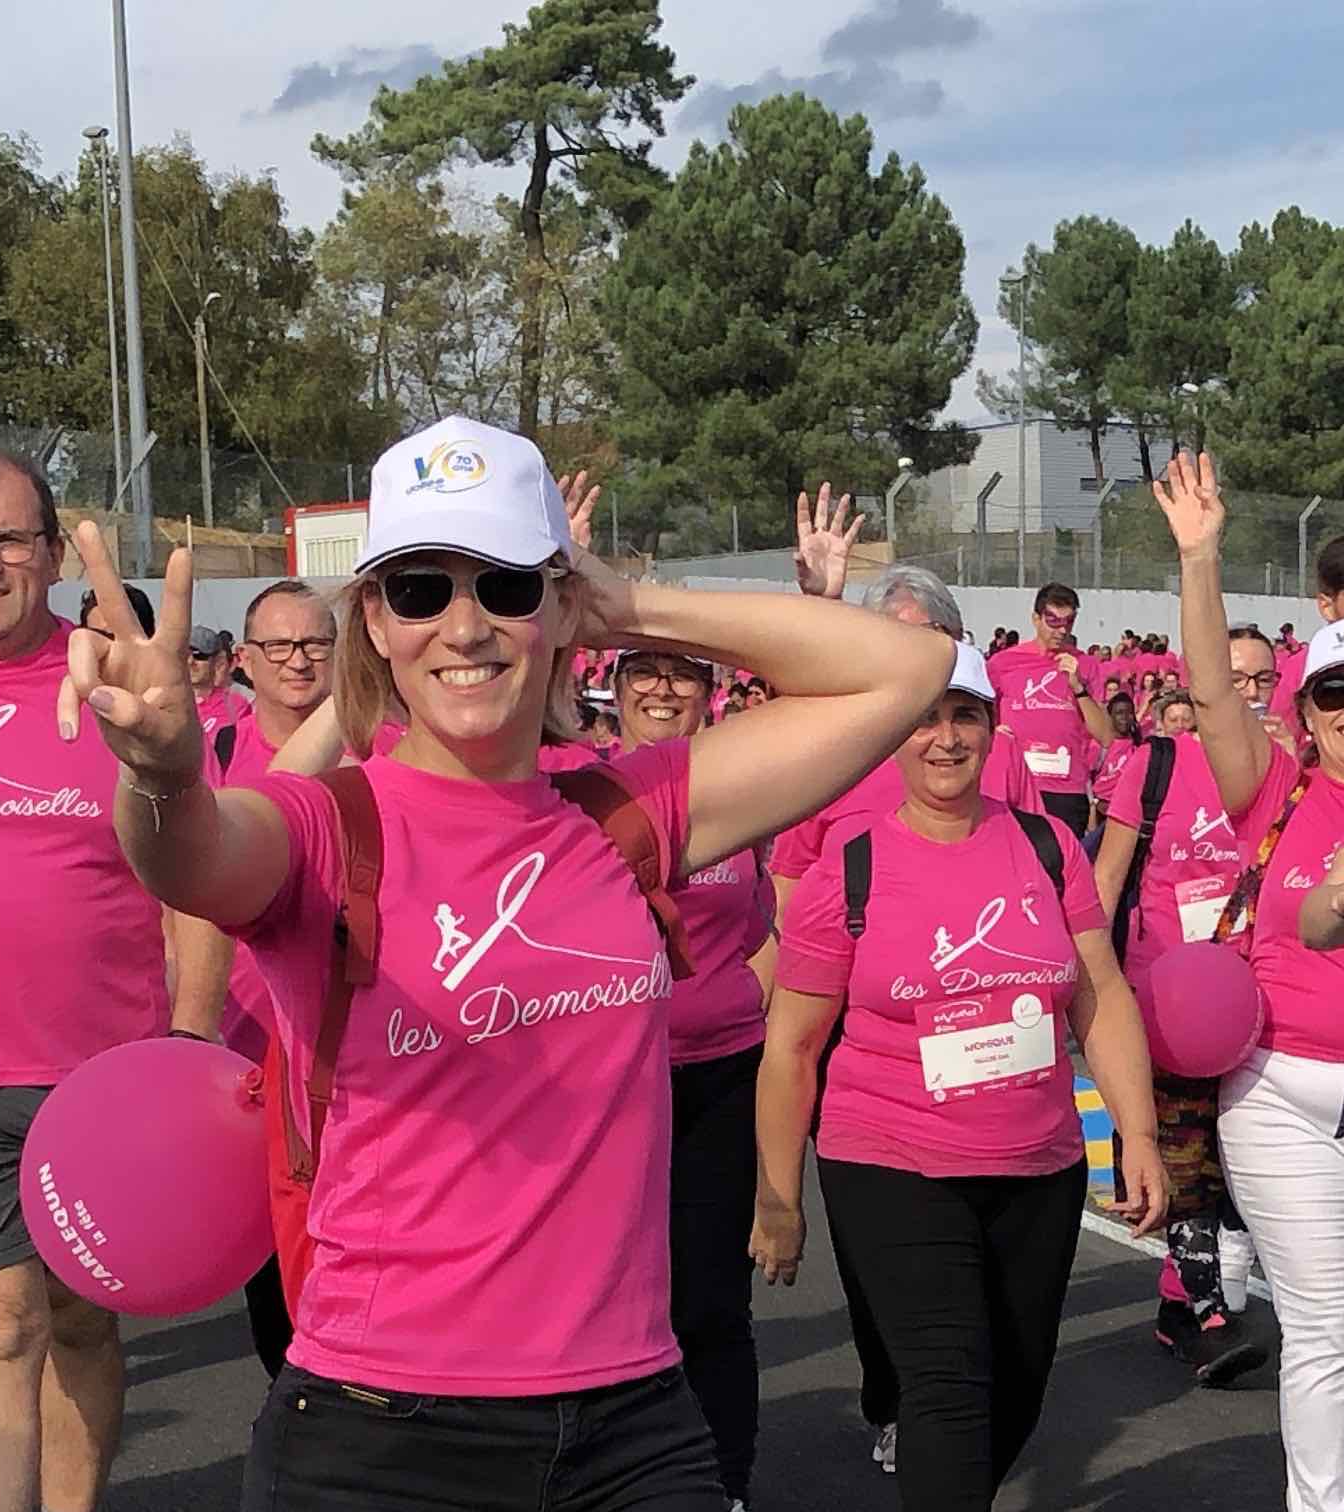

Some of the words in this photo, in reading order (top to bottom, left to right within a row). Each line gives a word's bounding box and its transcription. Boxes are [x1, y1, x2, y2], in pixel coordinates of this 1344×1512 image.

[455, 455, 473, 465] 70
[1193, 841, 1240, 862] Dem
[1282, 865, 1315, 889] les
[890, 975, 927, 1000] les
[387, 1007, 442, 1057] les
[964, 1033, 1016, 1053] MONIQUE
[38, 1161, 125, 1292] L'ARLEQUIN
